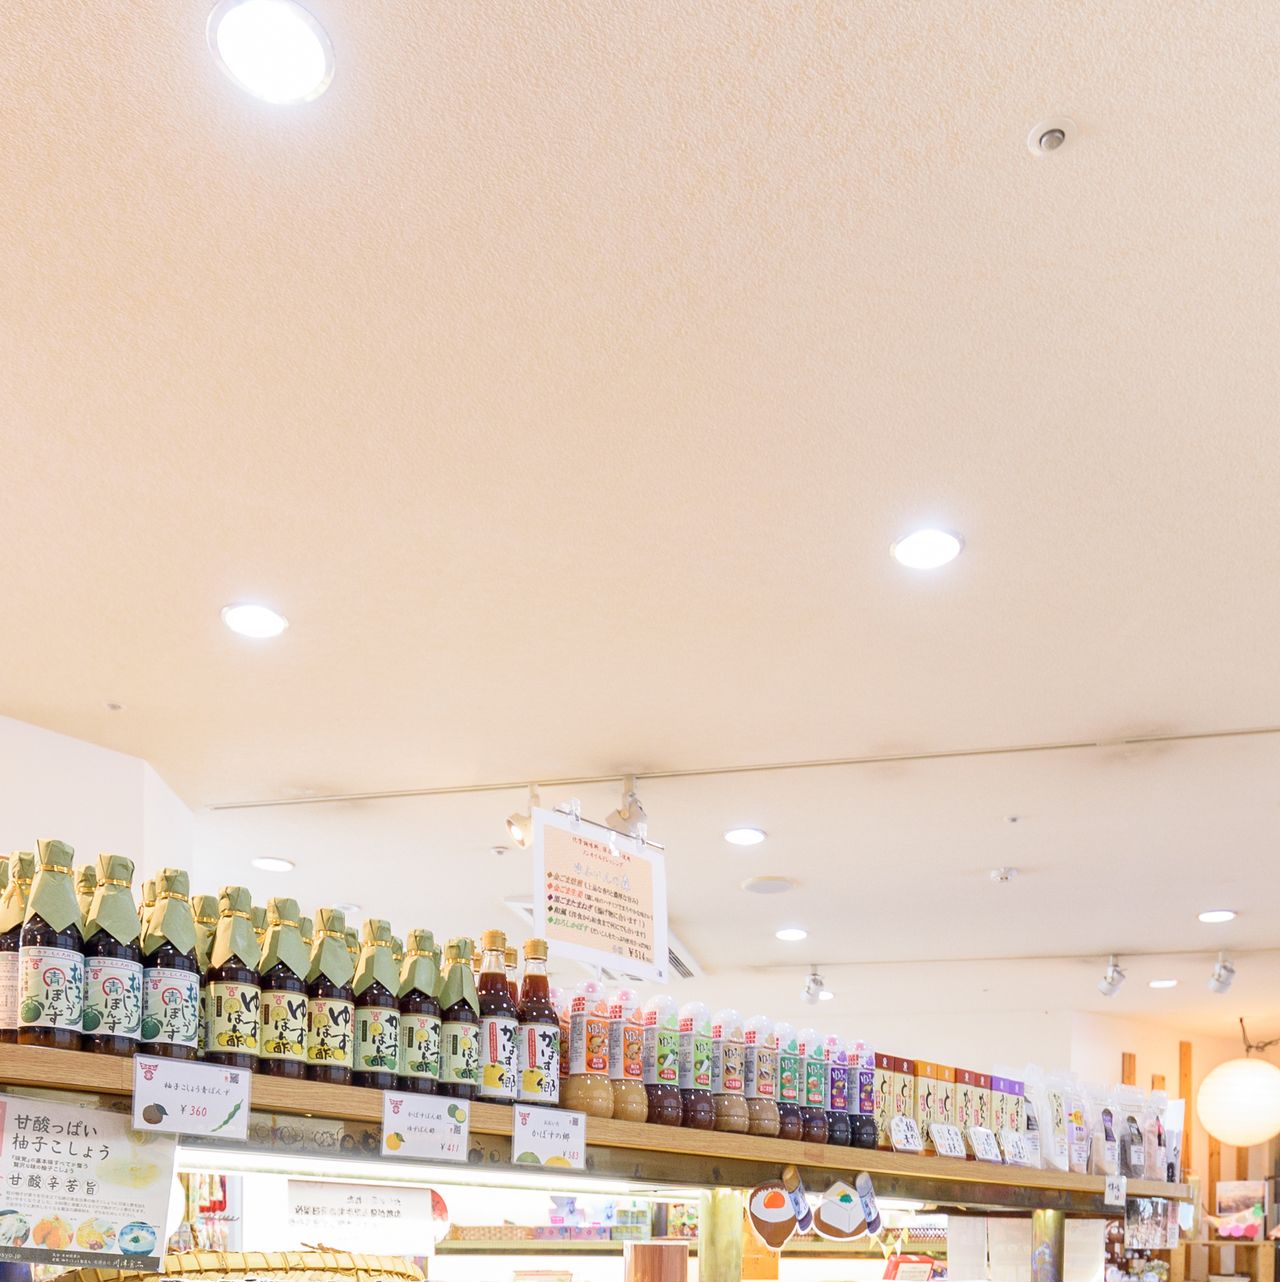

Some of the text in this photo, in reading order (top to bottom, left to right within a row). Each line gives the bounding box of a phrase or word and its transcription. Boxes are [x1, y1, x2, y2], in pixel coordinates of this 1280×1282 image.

[14, 1113, 98, 1138] 甘酸っぱい
[12, 1132, 111, 1161] 柚子こしょう
[9, 1173, 96, 1195] 甘 酸 辛 苦 旨
